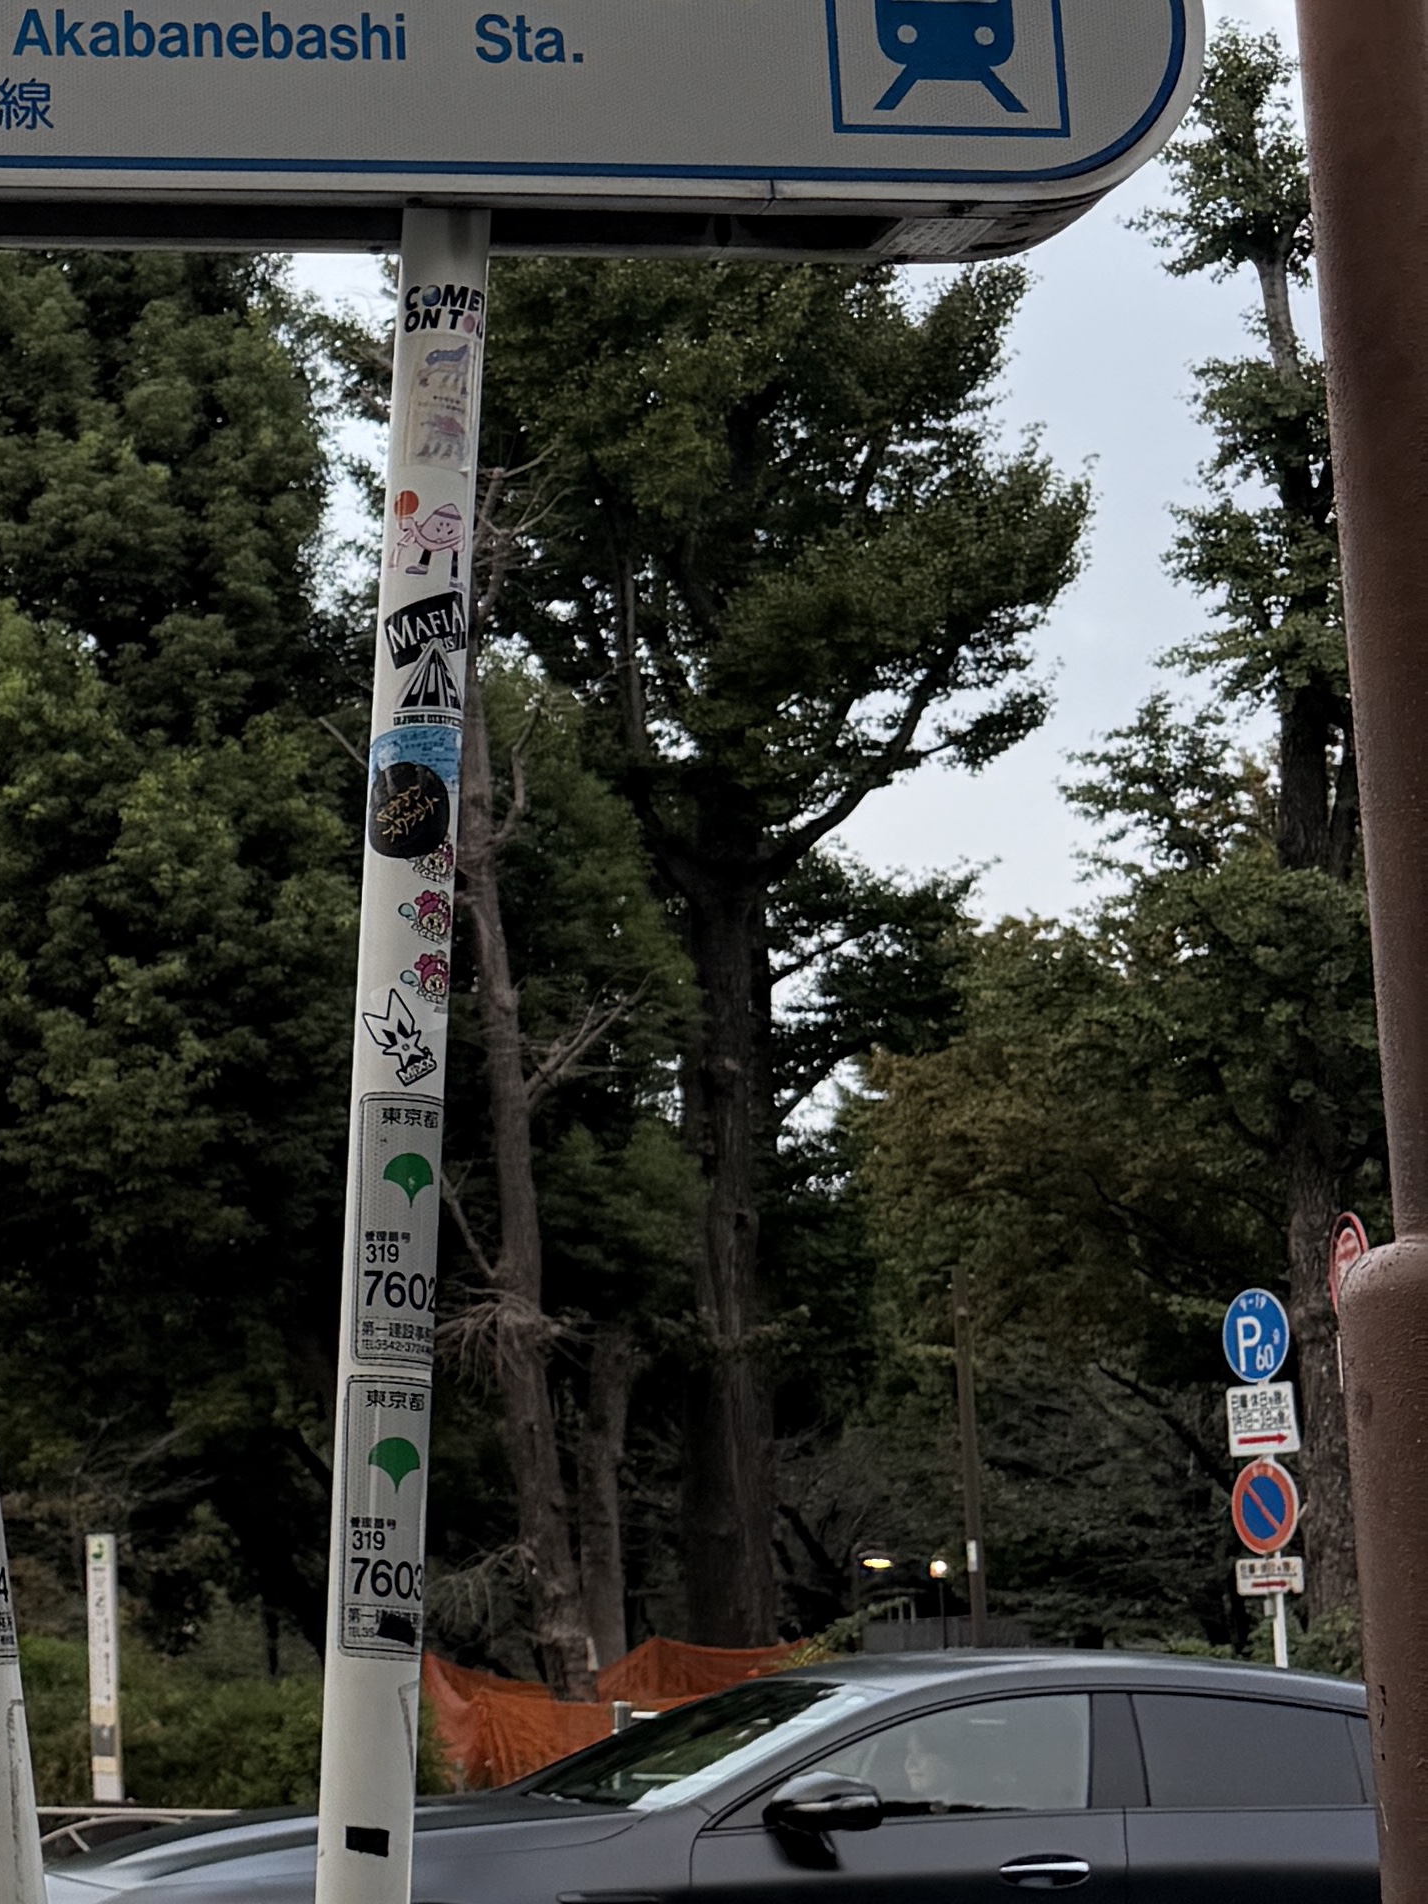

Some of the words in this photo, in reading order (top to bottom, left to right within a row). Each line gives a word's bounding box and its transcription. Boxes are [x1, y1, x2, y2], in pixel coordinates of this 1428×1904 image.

[13, 9, 406, 61] Akabanebashi
[476, 14, 583, 63] Sta.
[404, 308, 442, 333] ON
[388, 600, 465, 654] MAFIA
[381, 1107, 439, 1129] 東京都
[366, 1243, 399, 1264] 319
[1237, 1316, 1262, 1371] P
[1256, 1344, 1275, 1372] 60
[365, 1390, 425, 1411] 東京都
[352, 1530, 386, 1551] 319
